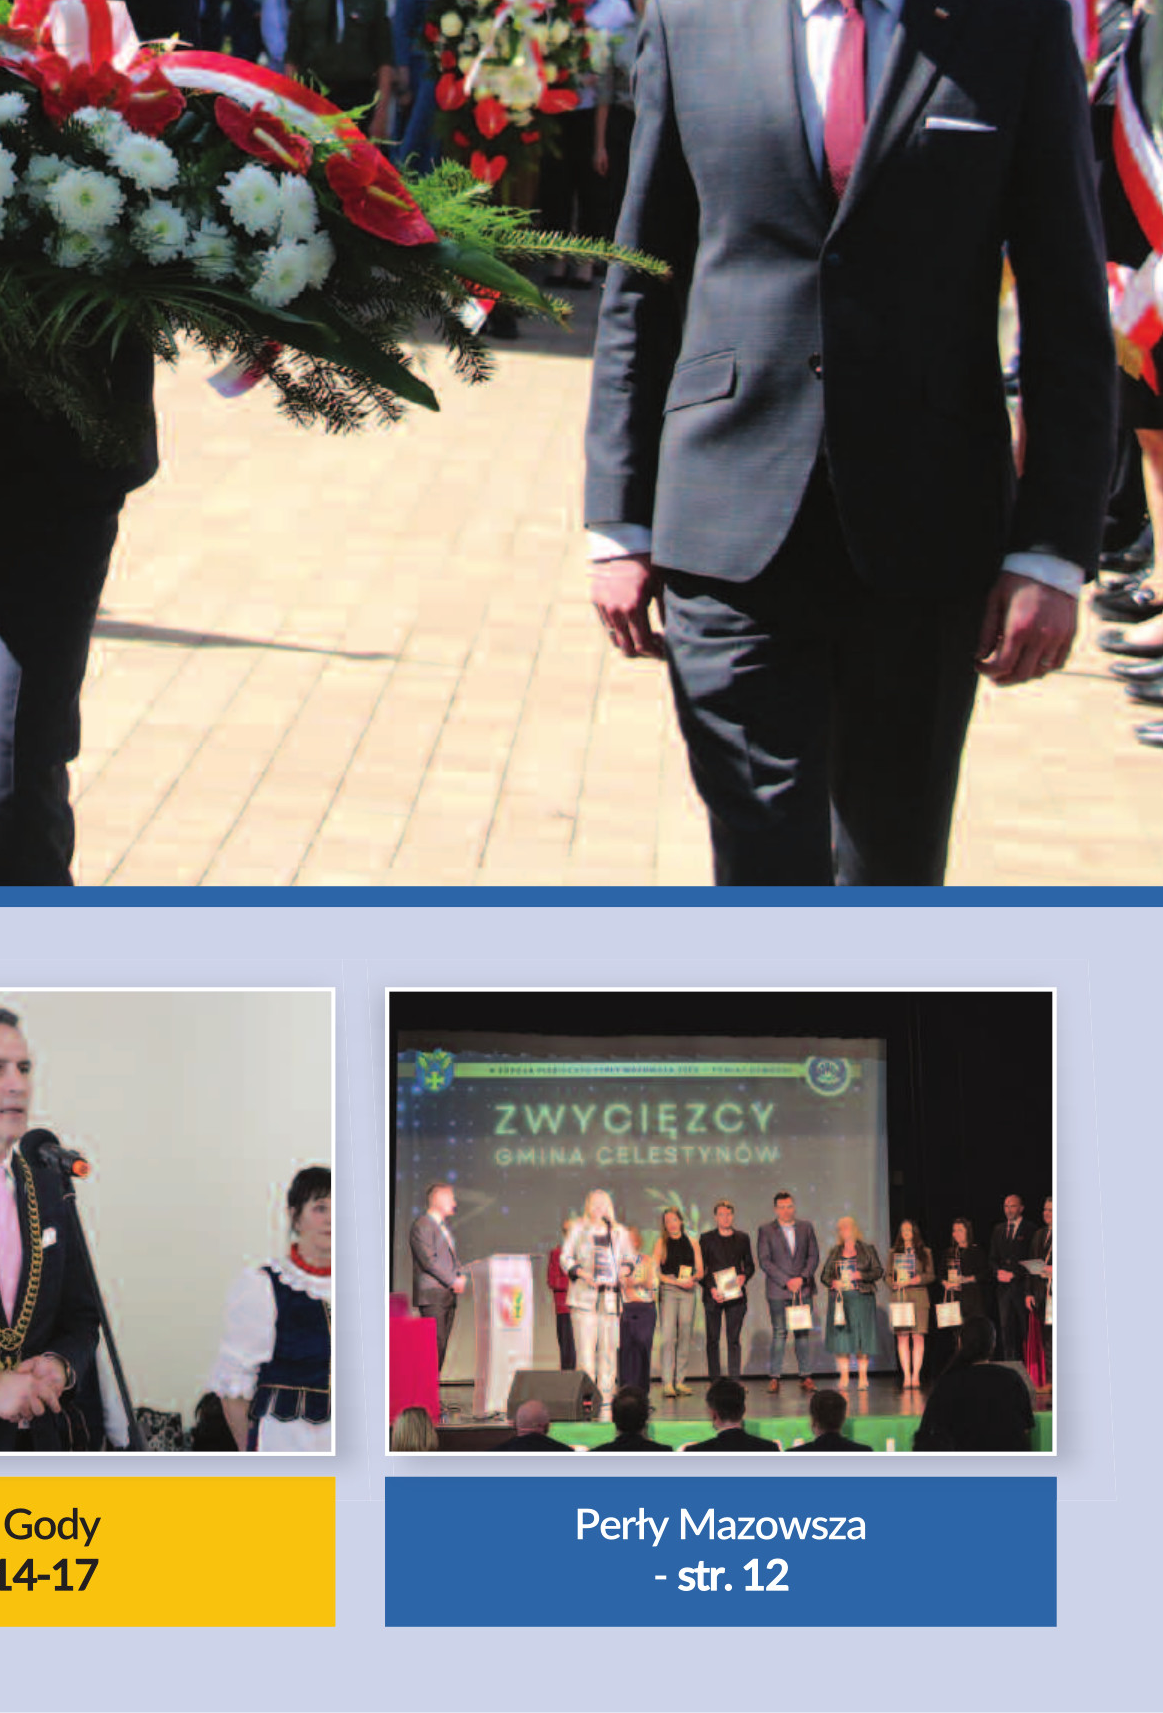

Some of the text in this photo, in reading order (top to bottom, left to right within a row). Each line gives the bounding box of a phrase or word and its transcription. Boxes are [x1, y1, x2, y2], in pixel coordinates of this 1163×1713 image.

[494, 1102, 776, 1140] ZWYCIĘZCY
[494, 1142, 780, 1166] GMINA CELESTYNÓW
[3, 1507, 102, 1548] Gody
[576, 1507, 866, 1548] Perły Mazowsza
[677, 1560, 733, 1592] str.
[742, 1557, 790, 1592] 12
